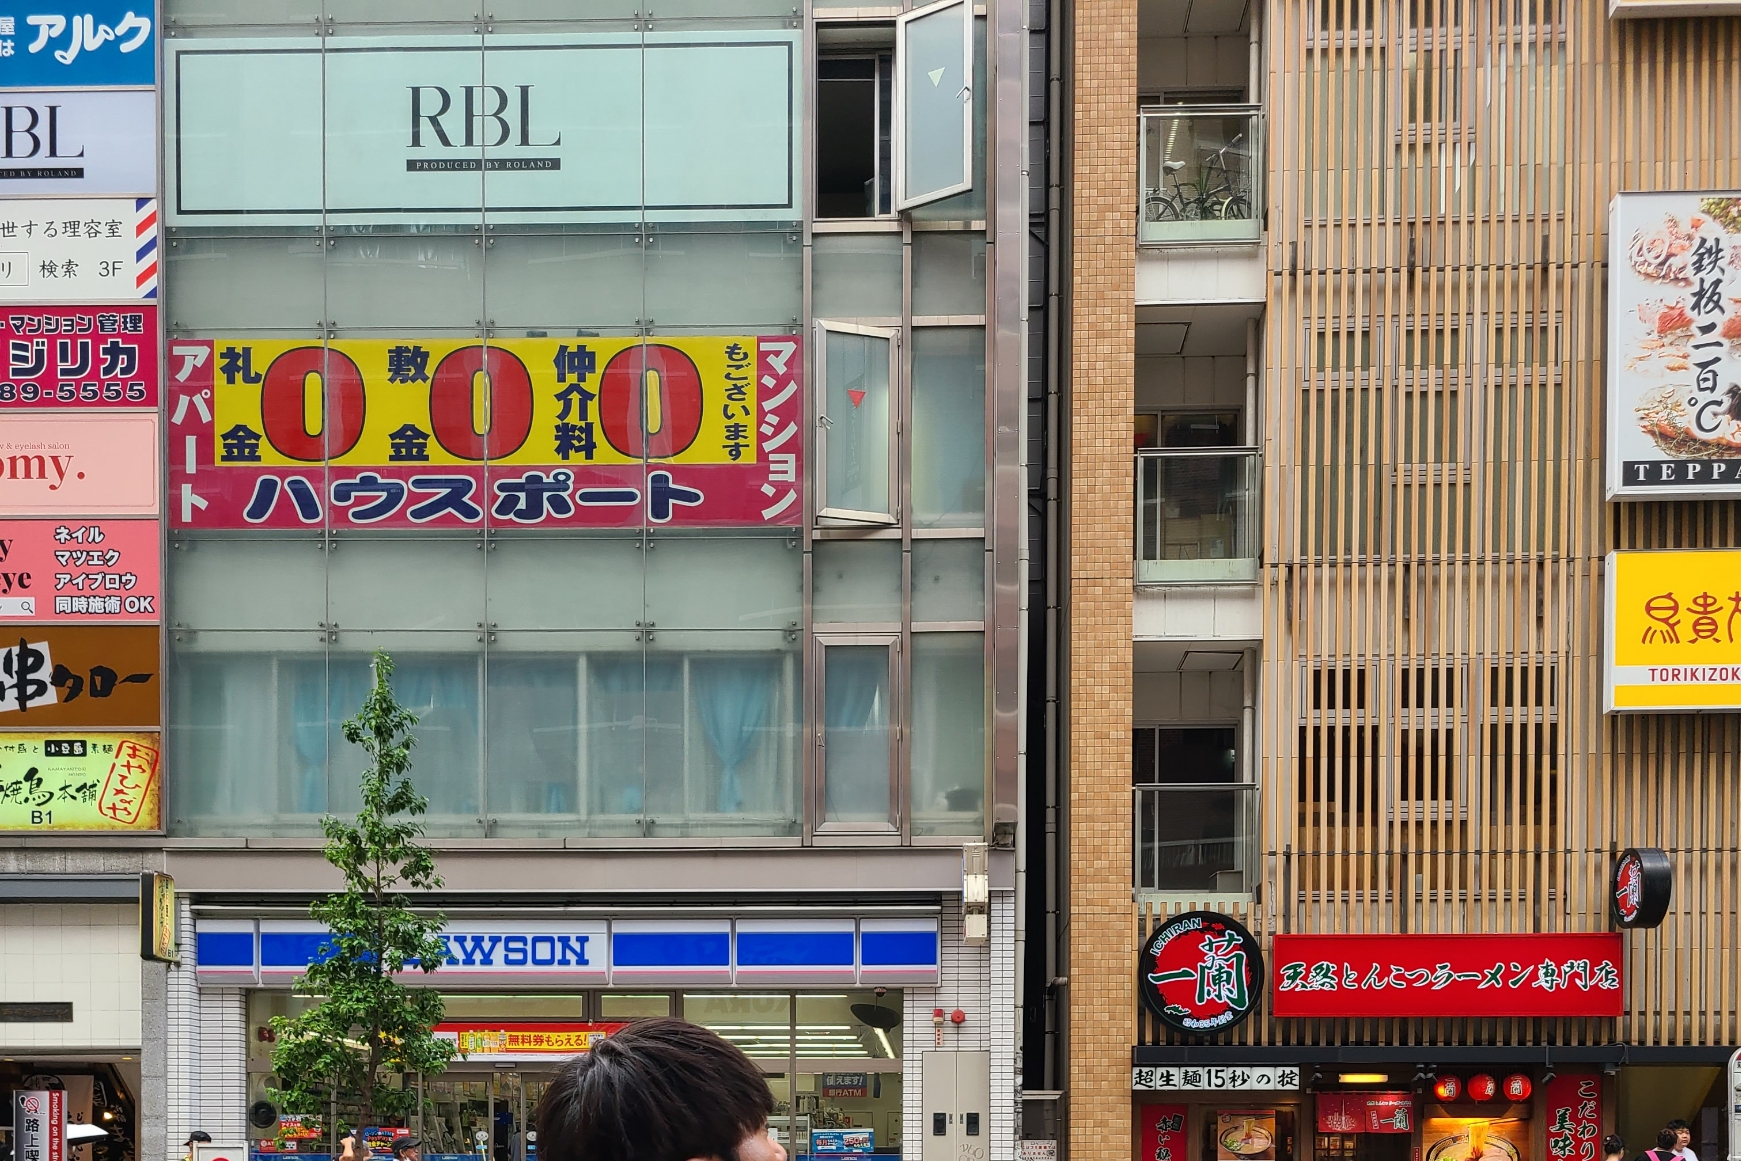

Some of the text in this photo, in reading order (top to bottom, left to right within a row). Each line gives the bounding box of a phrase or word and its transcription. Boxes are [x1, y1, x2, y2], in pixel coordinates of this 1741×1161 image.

[26, 11, 151, 65] アルク
[405, 85, 561, 148] RBL
[416, 160, 552, 170] PRODUCED BY ROLAND
[0, 219, 123, 239] 世する理容室
[39, 258, 124, 279] 検索 3F
[9, 338, 139, 379] ジリカ
[0, 381, 147, 402] 89-5555
[553, 344, 597, 460] 仲介料
[721, 342, 752, 461] もございます
[219, 346, 263, 462] 礼金
[387, 345, 431, 462] 敷金
[171, 345, 212, 523] アパート
[759, 341, 798, 521] マンション
[14, 442, 46, 451] eyelash
[47, 442, 70, 450] salon
[243, 468, 705, 524] ハウスポート
[54, 525, 105, 544] ネイル
[54, 549, 120, 567] マツエク
[0, 571, 32, 594] ye
[54, 572, 137, 591] アイブロウ
[54, 595, 155, 614] 同時施術 OK
[1648, 667, 1741, 682] TORIKIZOK
[31, 811, 53, 825] B1
[1150, 918, 1202, 956] ICHIRAN
[1148, 930, 1248, 1010] 一蘭
[1279, 958, 1620, 992] 天然とんこつラーメン専門店
[1134, 1068, 1299, 1088] 超生麺15秒の掟
[51, 1092, 60, 1125] Smoking
[1380, 1108, 1409, 1130] 一蘭
[52, 1126, 58, 1136] on
[52, 1137, 60, 1150] the
